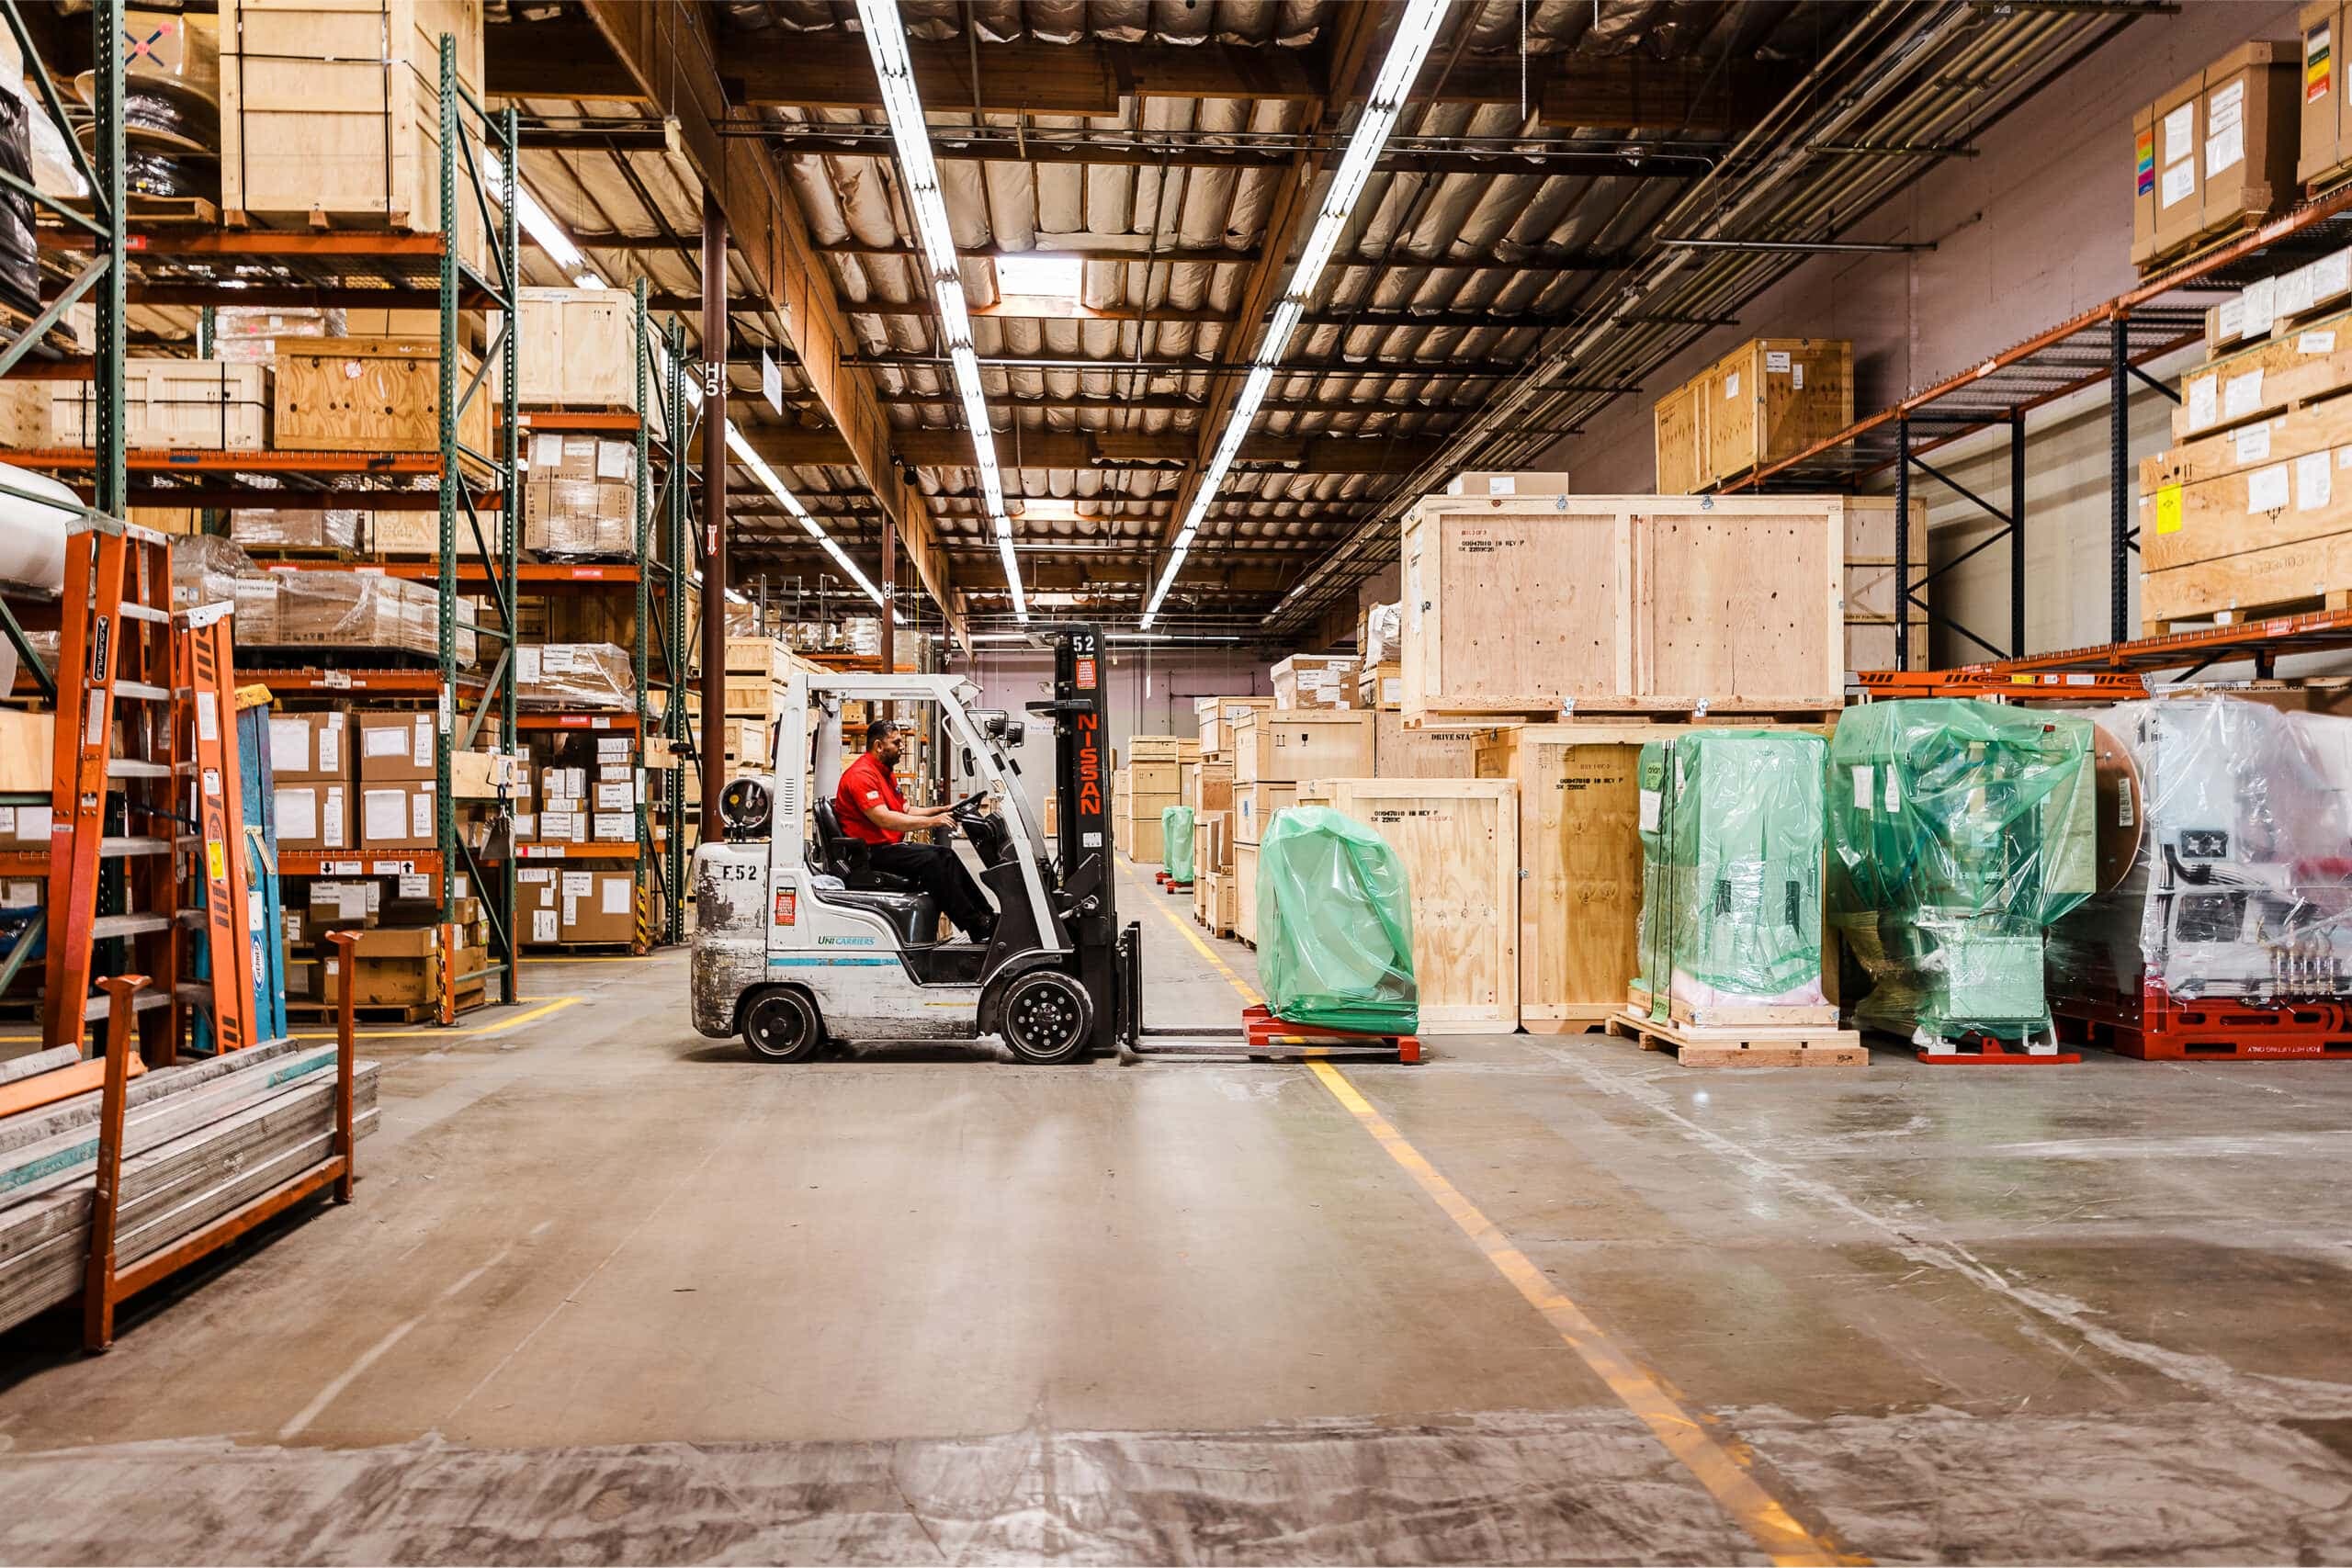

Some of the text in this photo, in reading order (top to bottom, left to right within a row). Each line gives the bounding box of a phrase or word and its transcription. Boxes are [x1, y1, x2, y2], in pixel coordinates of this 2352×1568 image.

[96, 627, 106, 680] LOUISVILLE
[1073, 636, 1095, 652] 52
[1078, 713, 1102, 816] NISSAN
